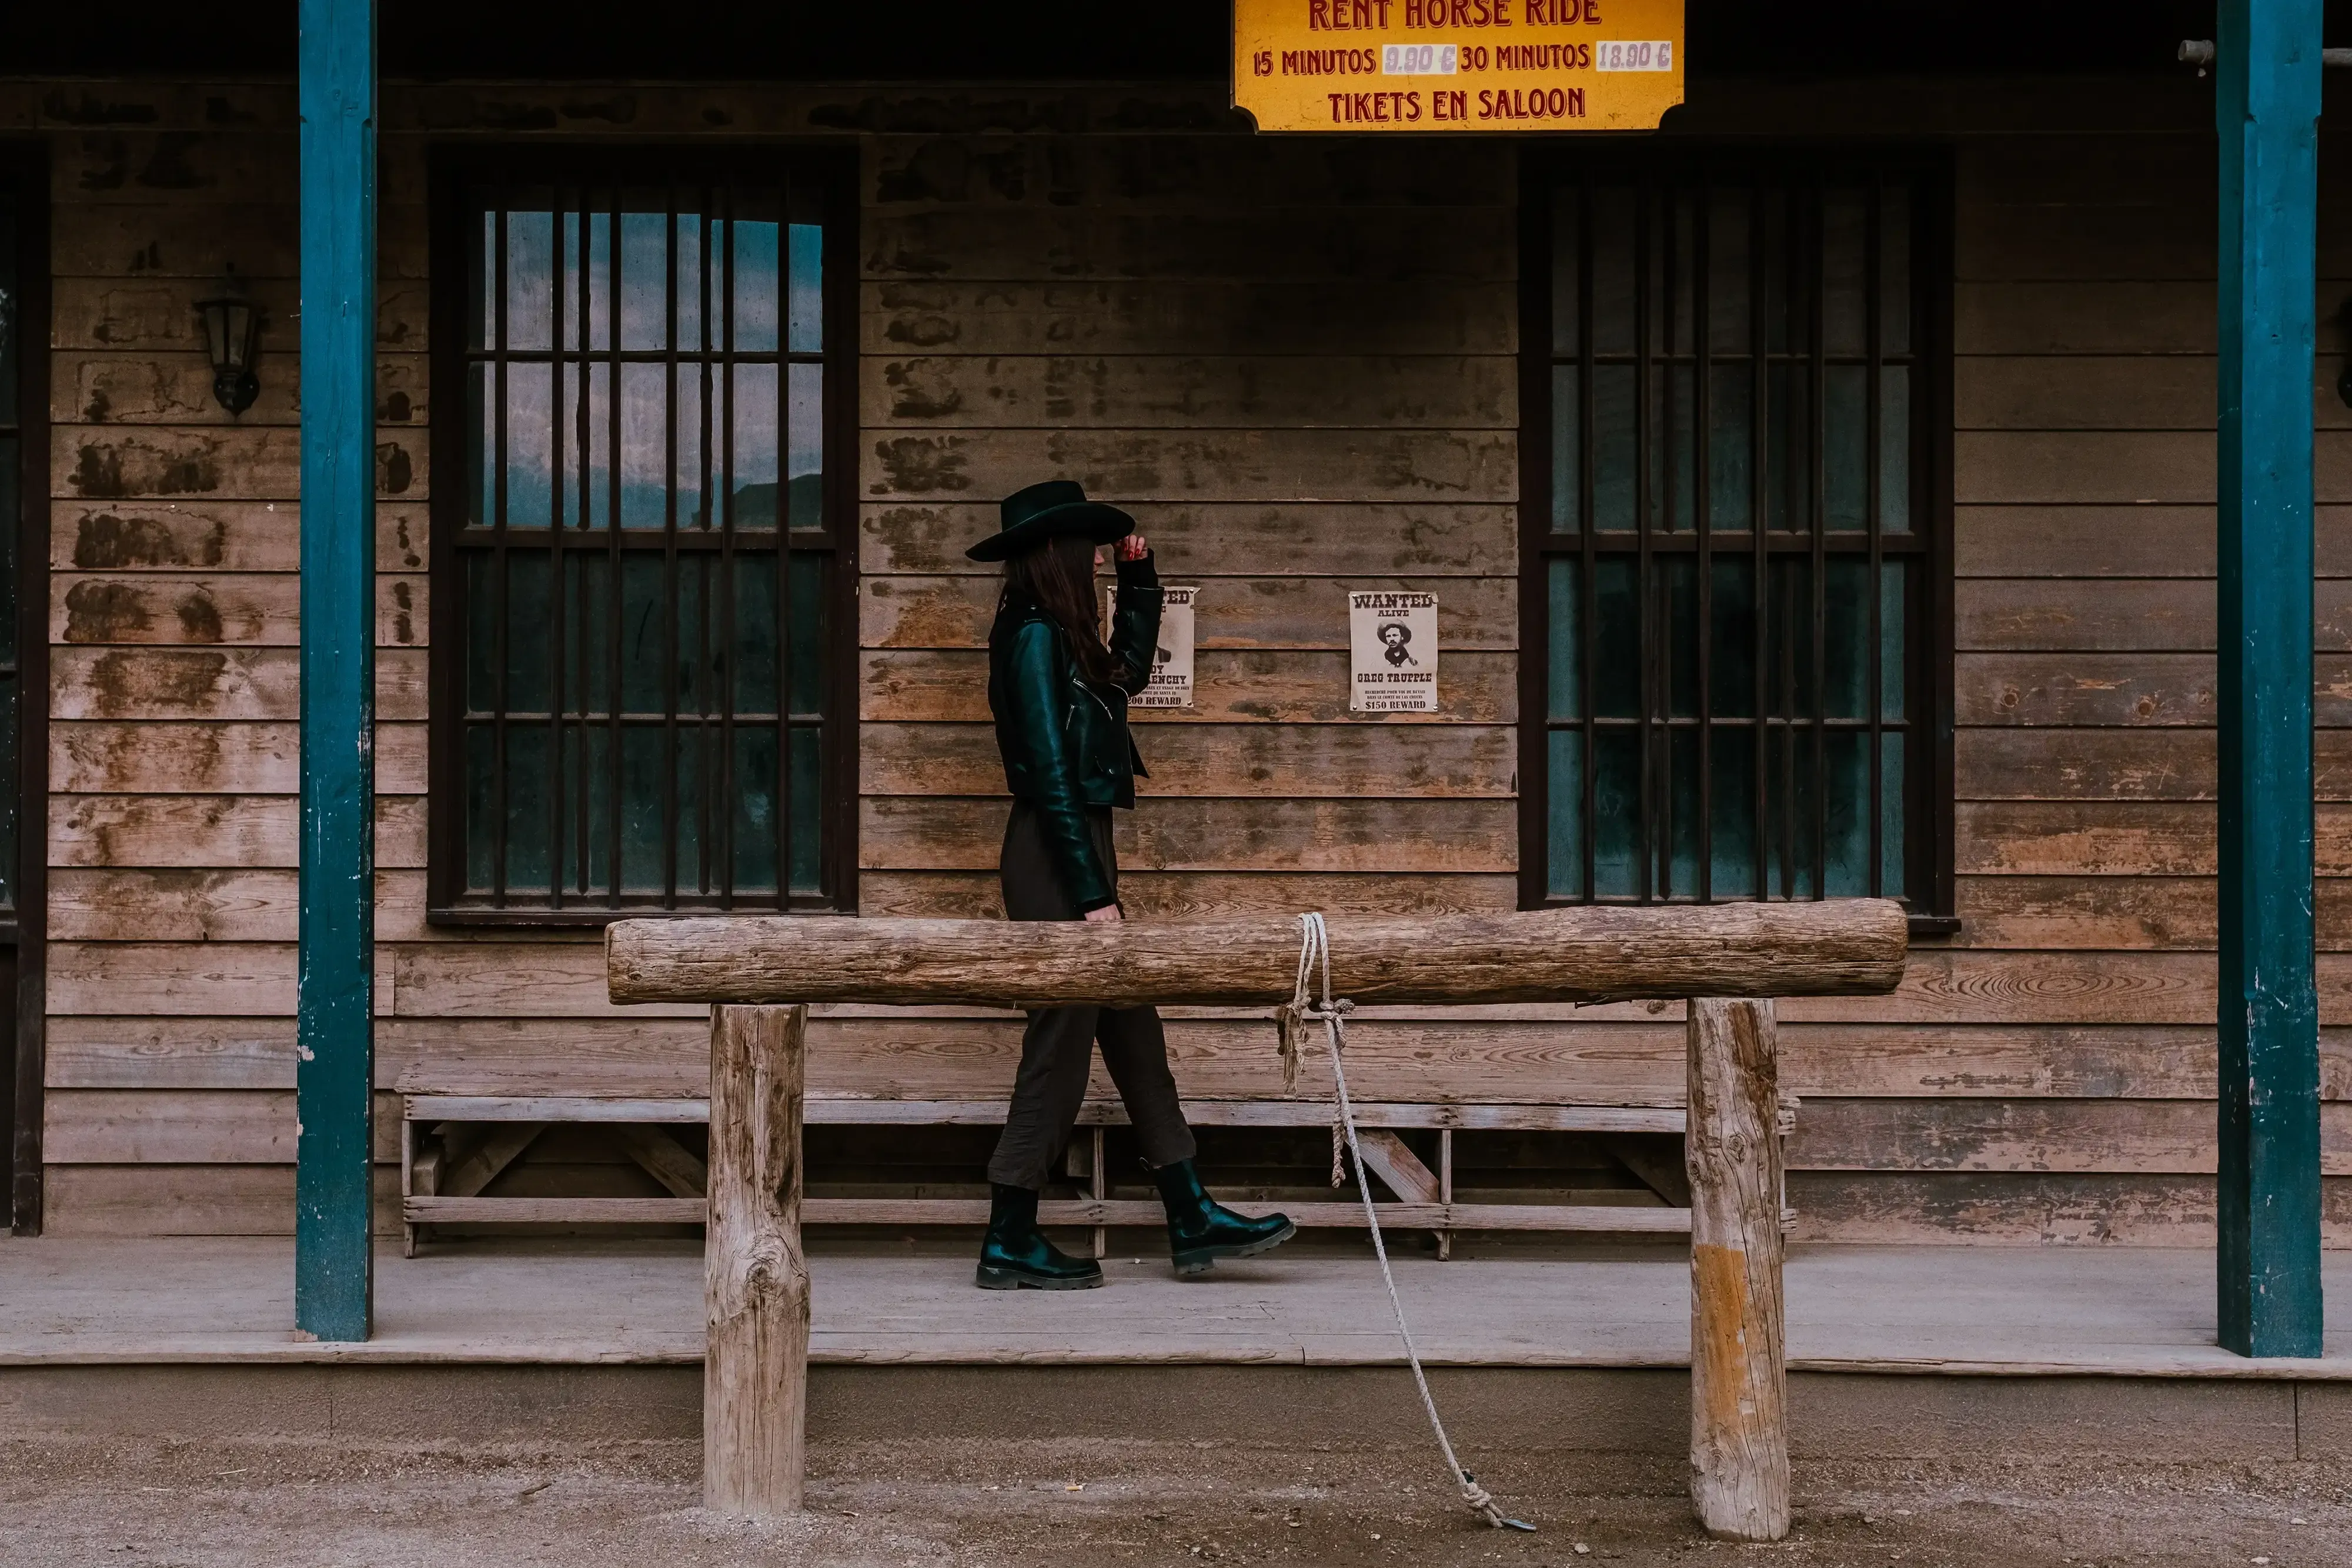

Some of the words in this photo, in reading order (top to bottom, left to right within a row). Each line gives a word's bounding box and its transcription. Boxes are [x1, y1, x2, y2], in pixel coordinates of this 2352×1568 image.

[1309, 0, 1393, 31] RENT
[1405, 0, 1512, 29] HORSE
[1525, 0, 1602, 26] RIDE
[1253, 51, 1274, 76] 15
[1282, 49, 1377, 76] MINUTOS
[1385, 45, 1434, 73] 9.90
[1438, 46, 1455, 73] €
[1461, 46, 1489, 72] 30
[1496, 44, 1591, 71] MINUTOS
[1599, 42, 1651, 70] 18.90
[1655, 43, 1671, 69] €
[1328, 91, 1422, 123] TIKETS
[1433, 91, 1467, 121] EN
[1478, 88, 1586, 120] SALOON
[1353, 594, 1434, 609] WANTED
[1148, 675, 1187, 684] ENCHY
[1358, 673, 1384, 683] GREG
[1387, 673, 1432, 683] TRUPPLE
[1128, 696, 1143, 705] 200
[1145, 697, 1181, 705] REWARD
[1365, 701, 1387, 710] $150
[1389, 701, 1426, 709] REWARD
